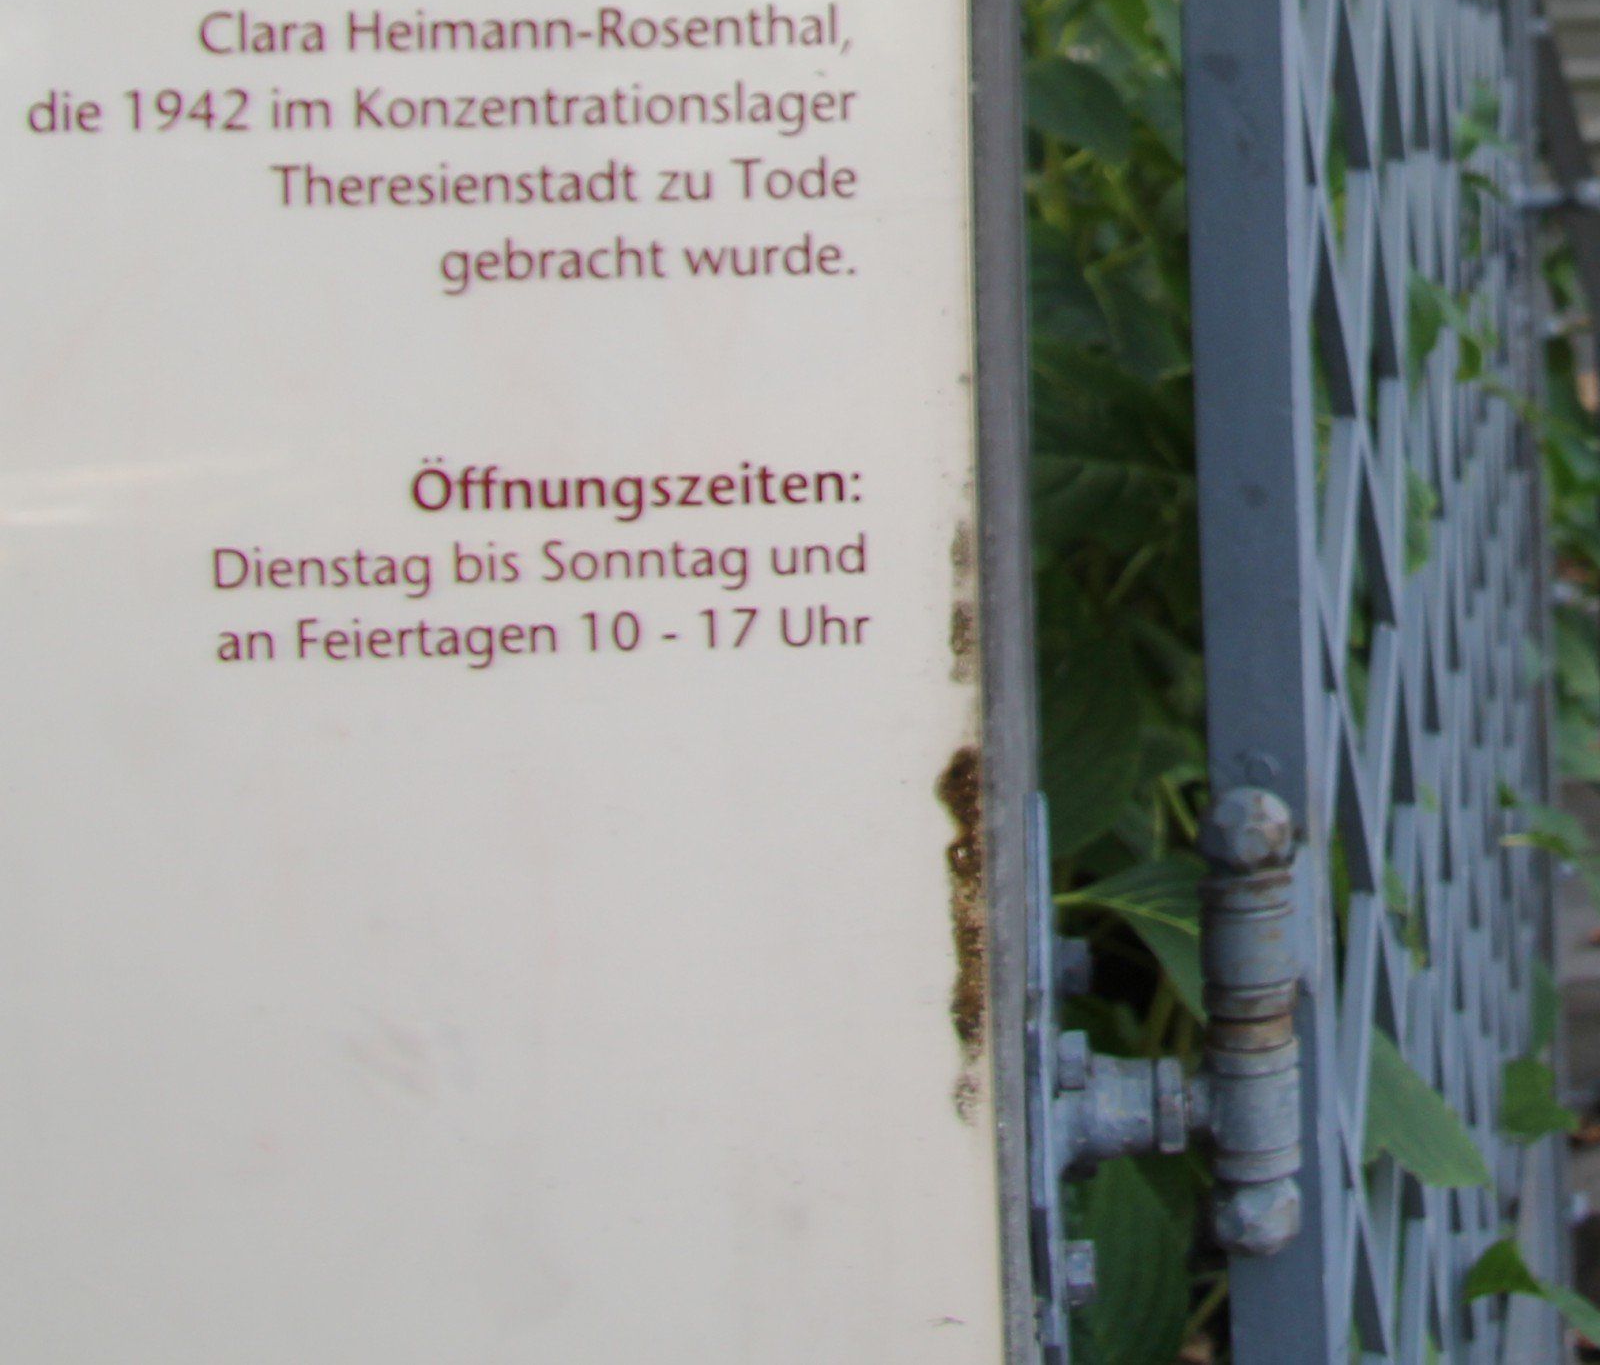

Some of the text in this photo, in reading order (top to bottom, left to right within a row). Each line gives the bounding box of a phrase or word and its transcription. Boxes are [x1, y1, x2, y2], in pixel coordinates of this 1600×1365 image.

[199, 3, 850, 55] Clara Heimann-Rosenthal,
[28, 81, 857, 137] die 1942 im Konzentrationslager
[270, 155, 858, 207] Theresienstadt zu Tode
[440, 232, 856, 296] gebracht wurde.
[410, 457, 862, 523] Öffnungszeiten:
[213, 532, 867, 599] Dienstag bis Sonntag und
[217, 630, 276, 662] an
[297, 617, 560, 670] Feiertagen
[581, 610, 643, 652] 10
[699, 607, 760, 649] 17
[780, 604, 871, 648] Uhr
